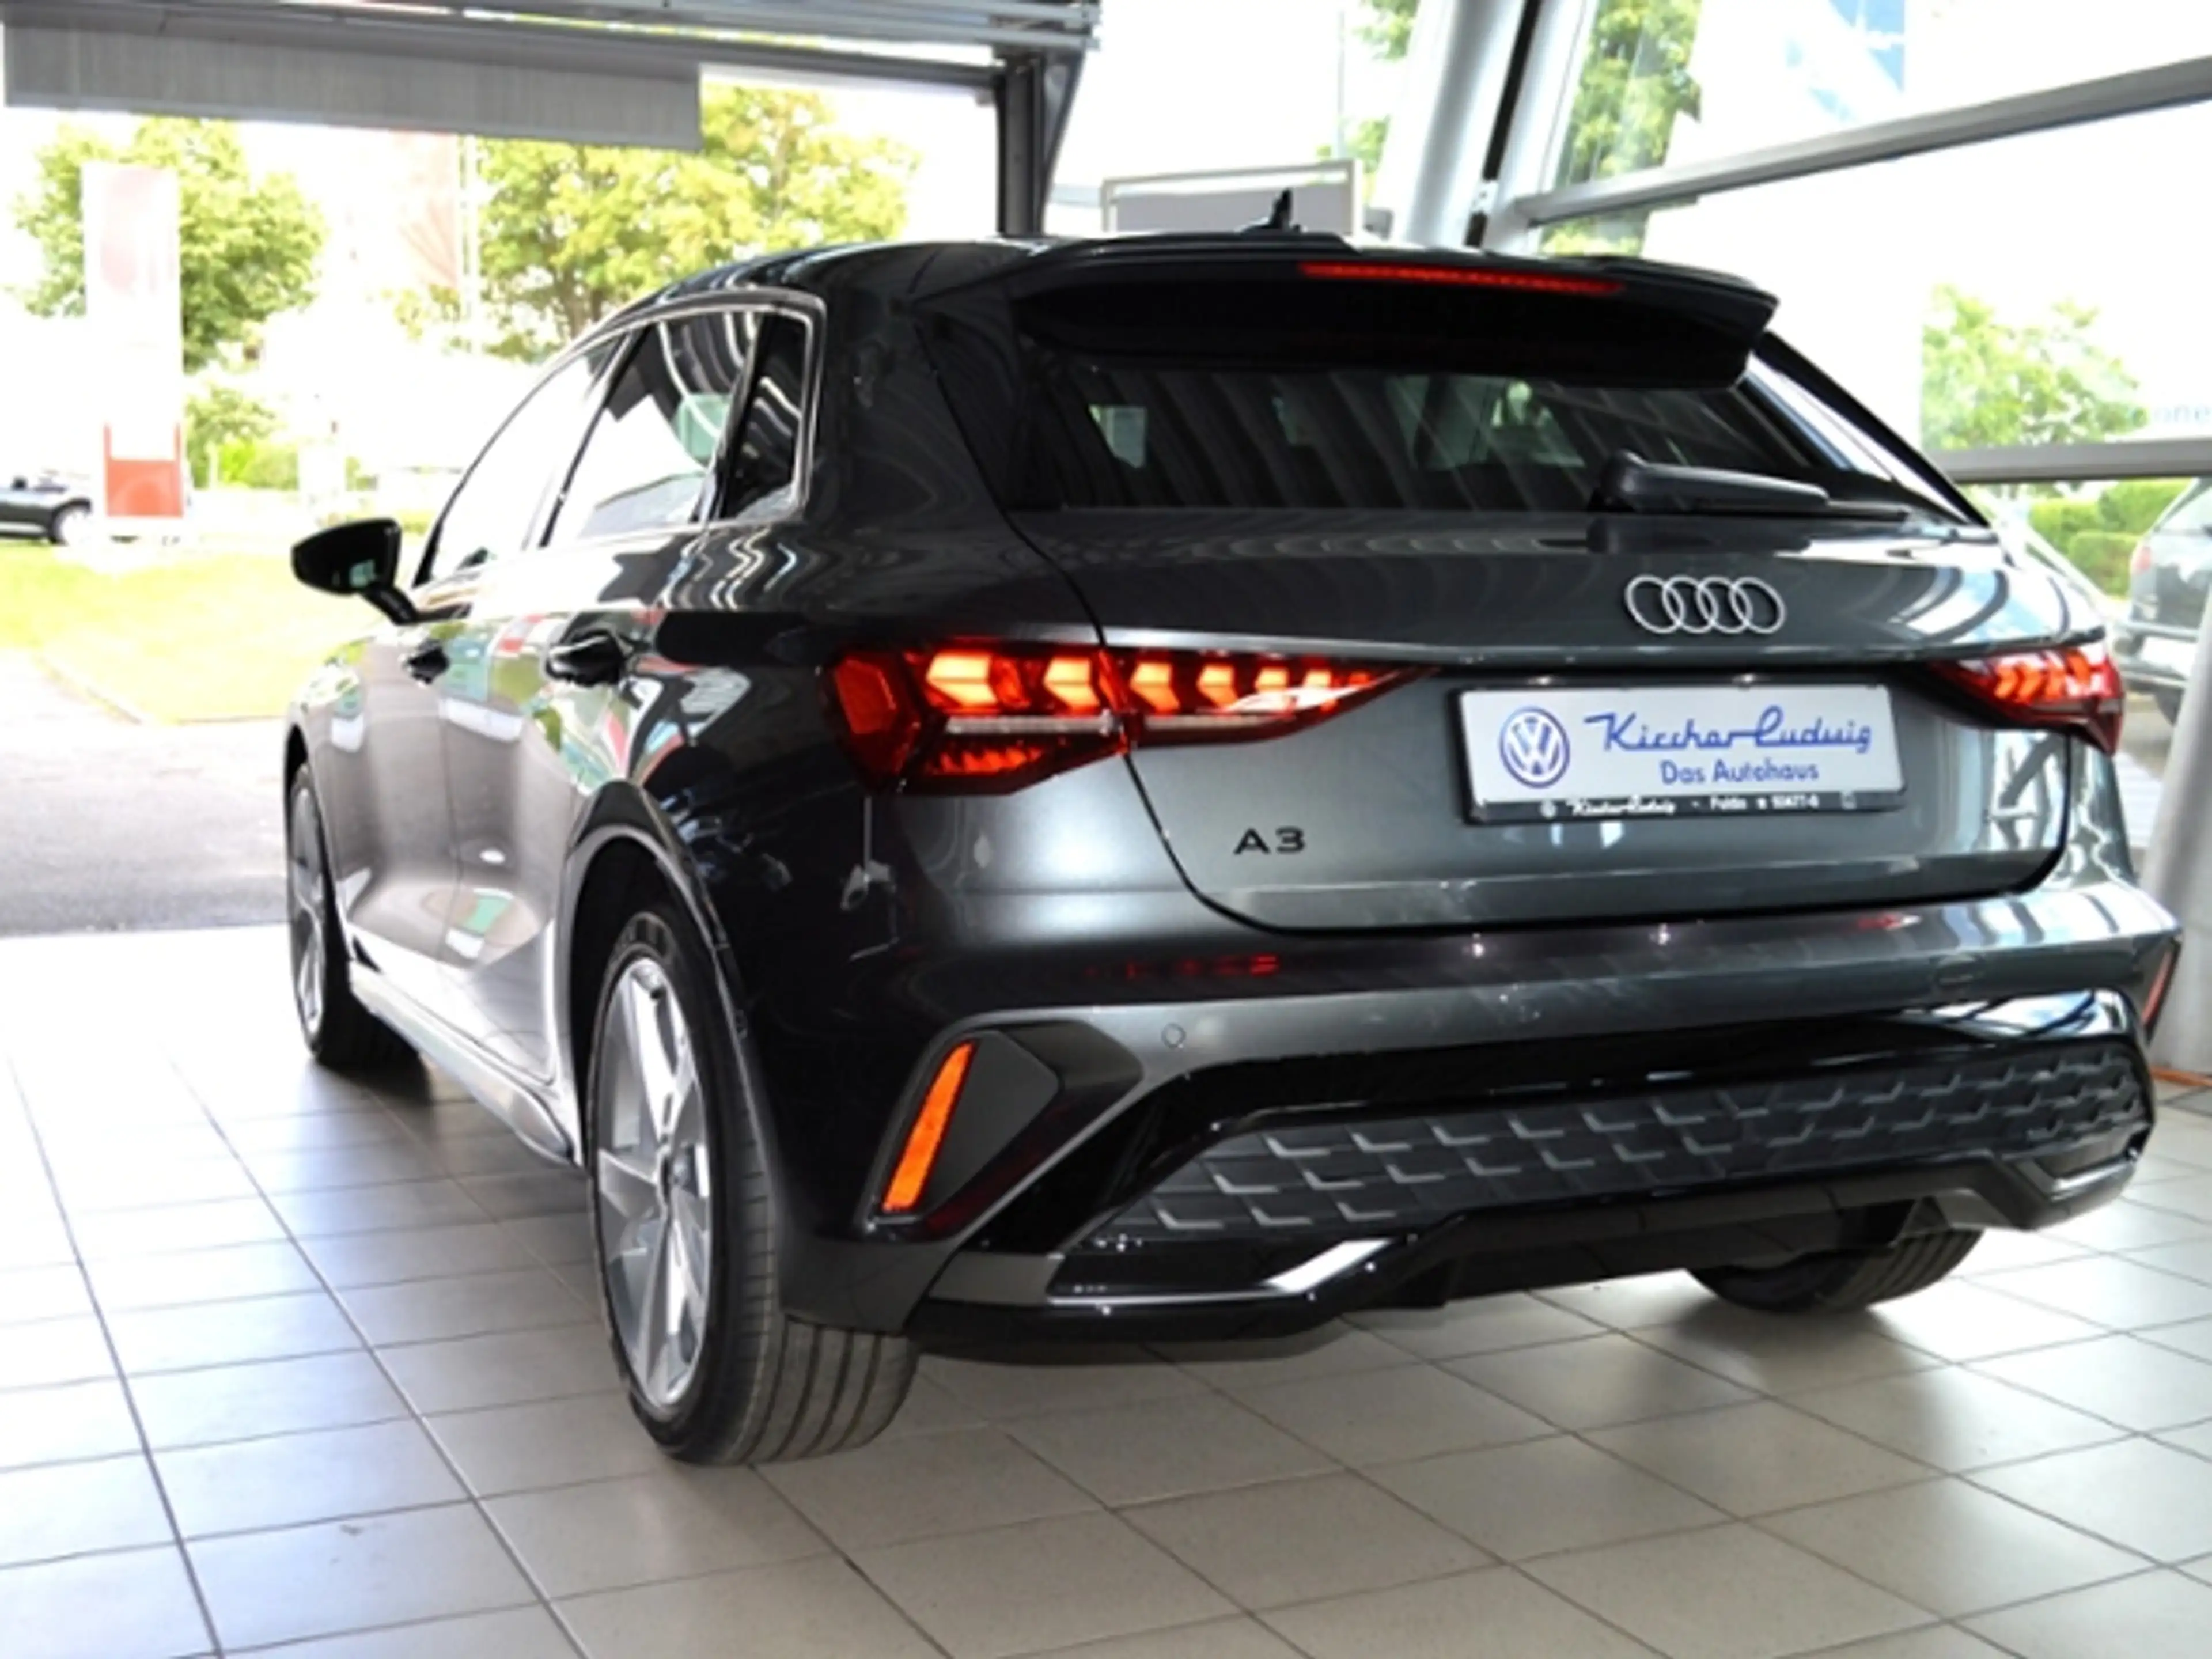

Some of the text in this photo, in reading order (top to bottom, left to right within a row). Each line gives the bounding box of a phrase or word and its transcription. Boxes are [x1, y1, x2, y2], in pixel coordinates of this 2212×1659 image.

[1755, 705, 1872, 754] Ludwig
[1660, 757, 1819, 785] Das Autohaus
[1233, 826, 1305, 855] A3
